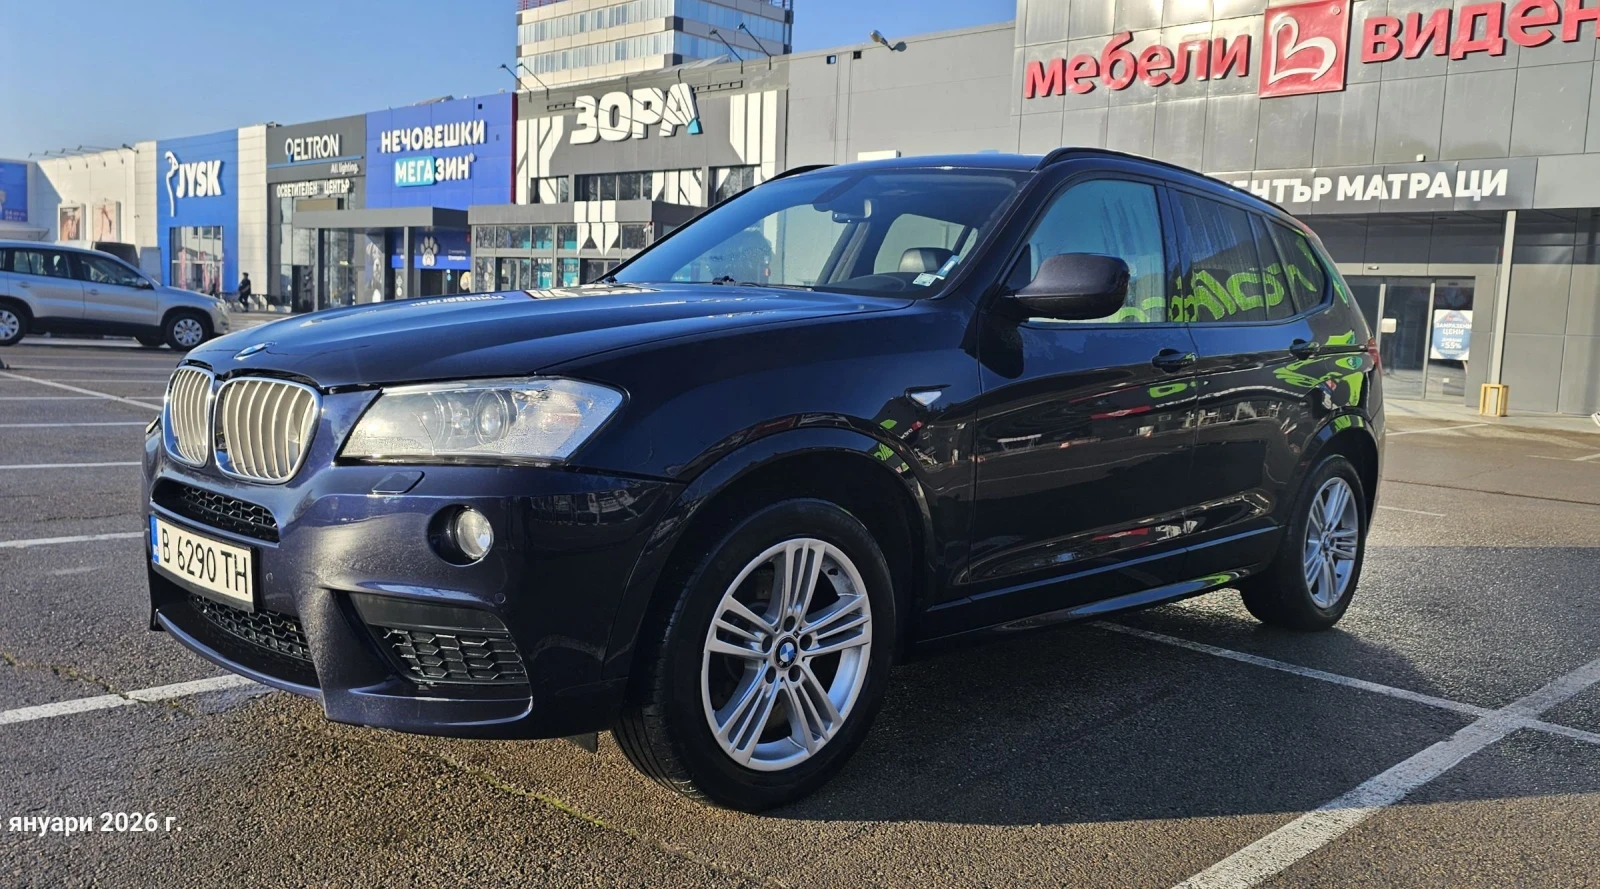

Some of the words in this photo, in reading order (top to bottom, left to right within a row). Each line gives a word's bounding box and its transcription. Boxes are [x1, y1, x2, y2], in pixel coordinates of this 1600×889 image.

[1025, 31, 1249, 98] мебели
[569, 82, 702, 145] ЗОРА
[381, 120, 485, 153] НЕЧОВЕШКИ
[176, 159, 222, 198] JYSK
[276, 182, 317, 198] ОСВЕТИТЕЛЕН
[324, 179, 350, 195] ЦЕНТЪР
[1226, 176, 1333, 203] НТЪР
[1336, 168, 1508, 202] МАТРАЦИ
[177, 535, 217, 583] 6290
